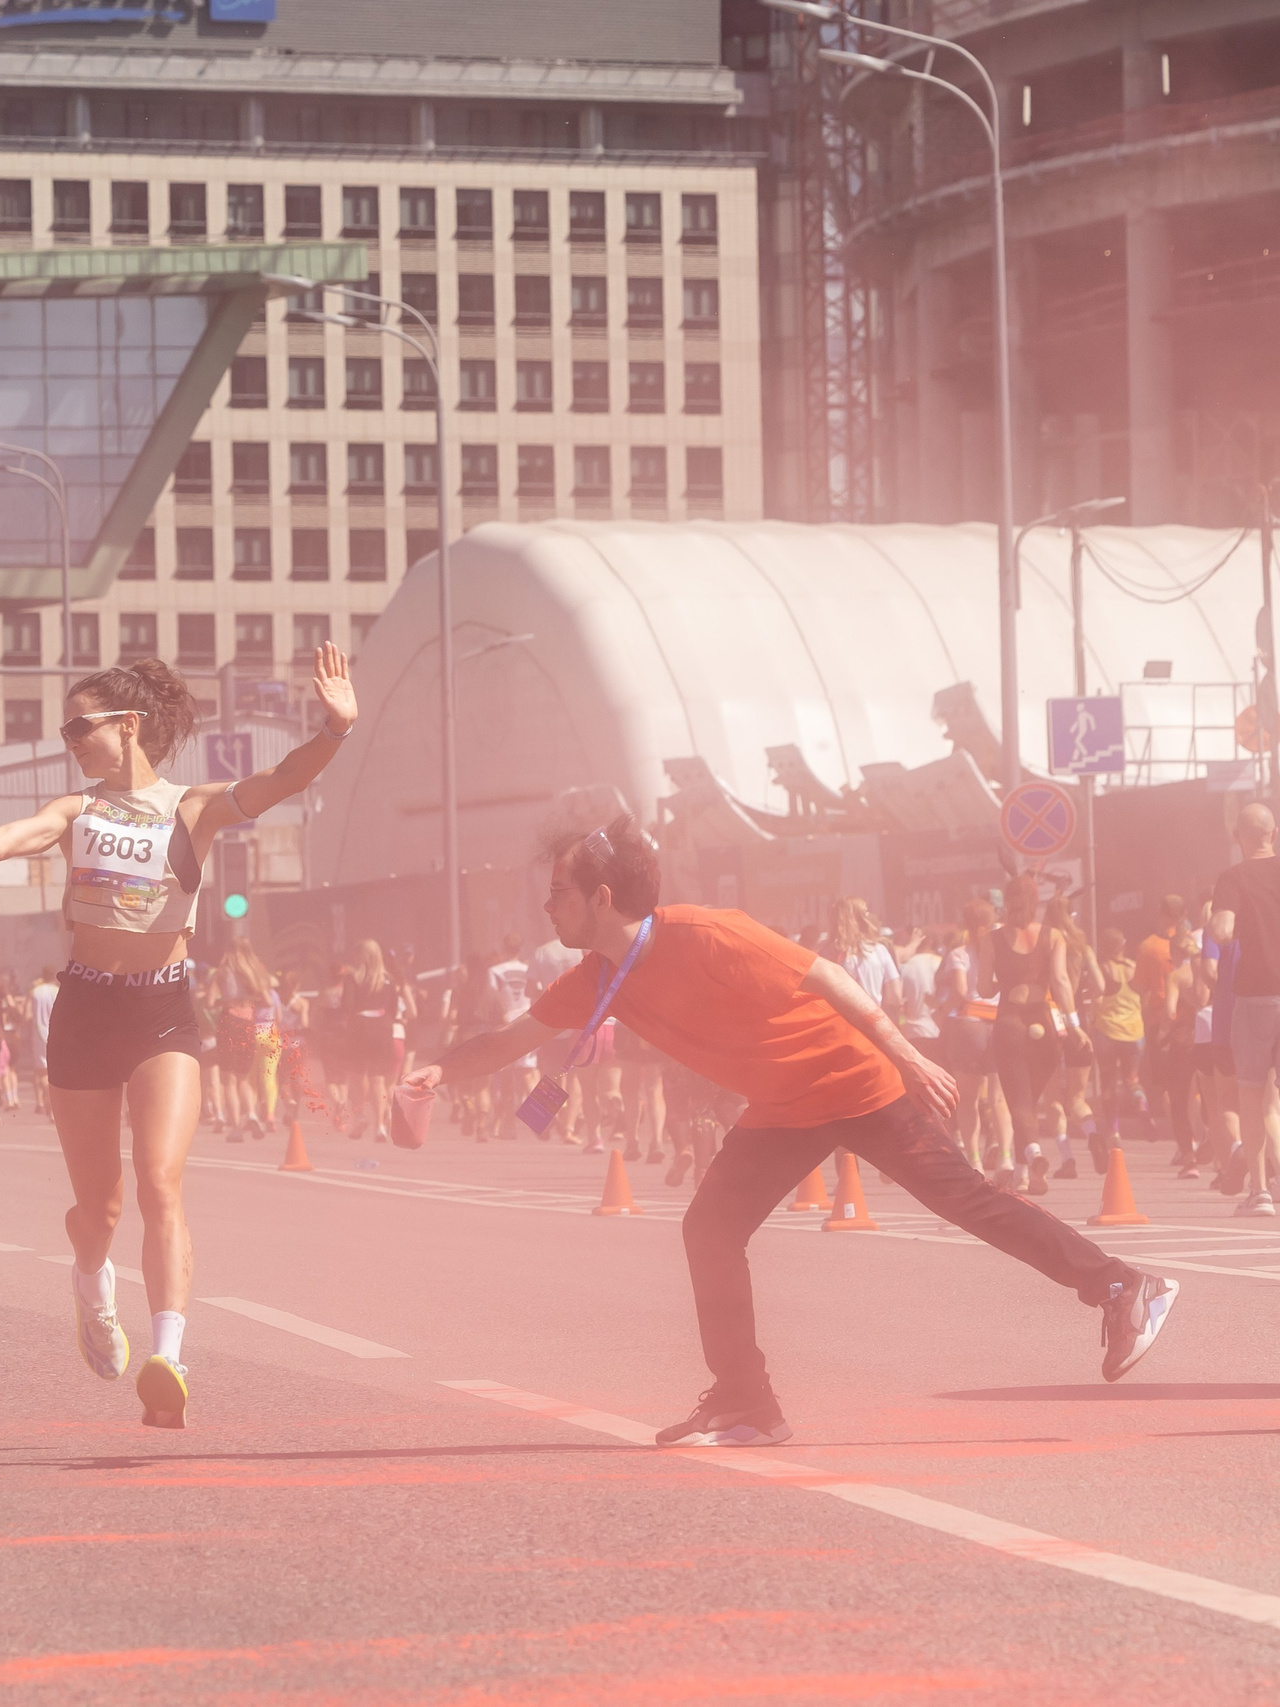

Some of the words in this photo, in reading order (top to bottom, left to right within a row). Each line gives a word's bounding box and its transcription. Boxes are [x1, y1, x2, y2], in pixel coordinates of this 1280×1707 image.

[83, 827, 154, 864] 7803
[629, 922, 650, 957] VOLUNTEER
[69, 961, 115, 986] PRO
[124, 961, 182, 987] NIKE
[590, 991, 614, 1027] VOLUNTEER
